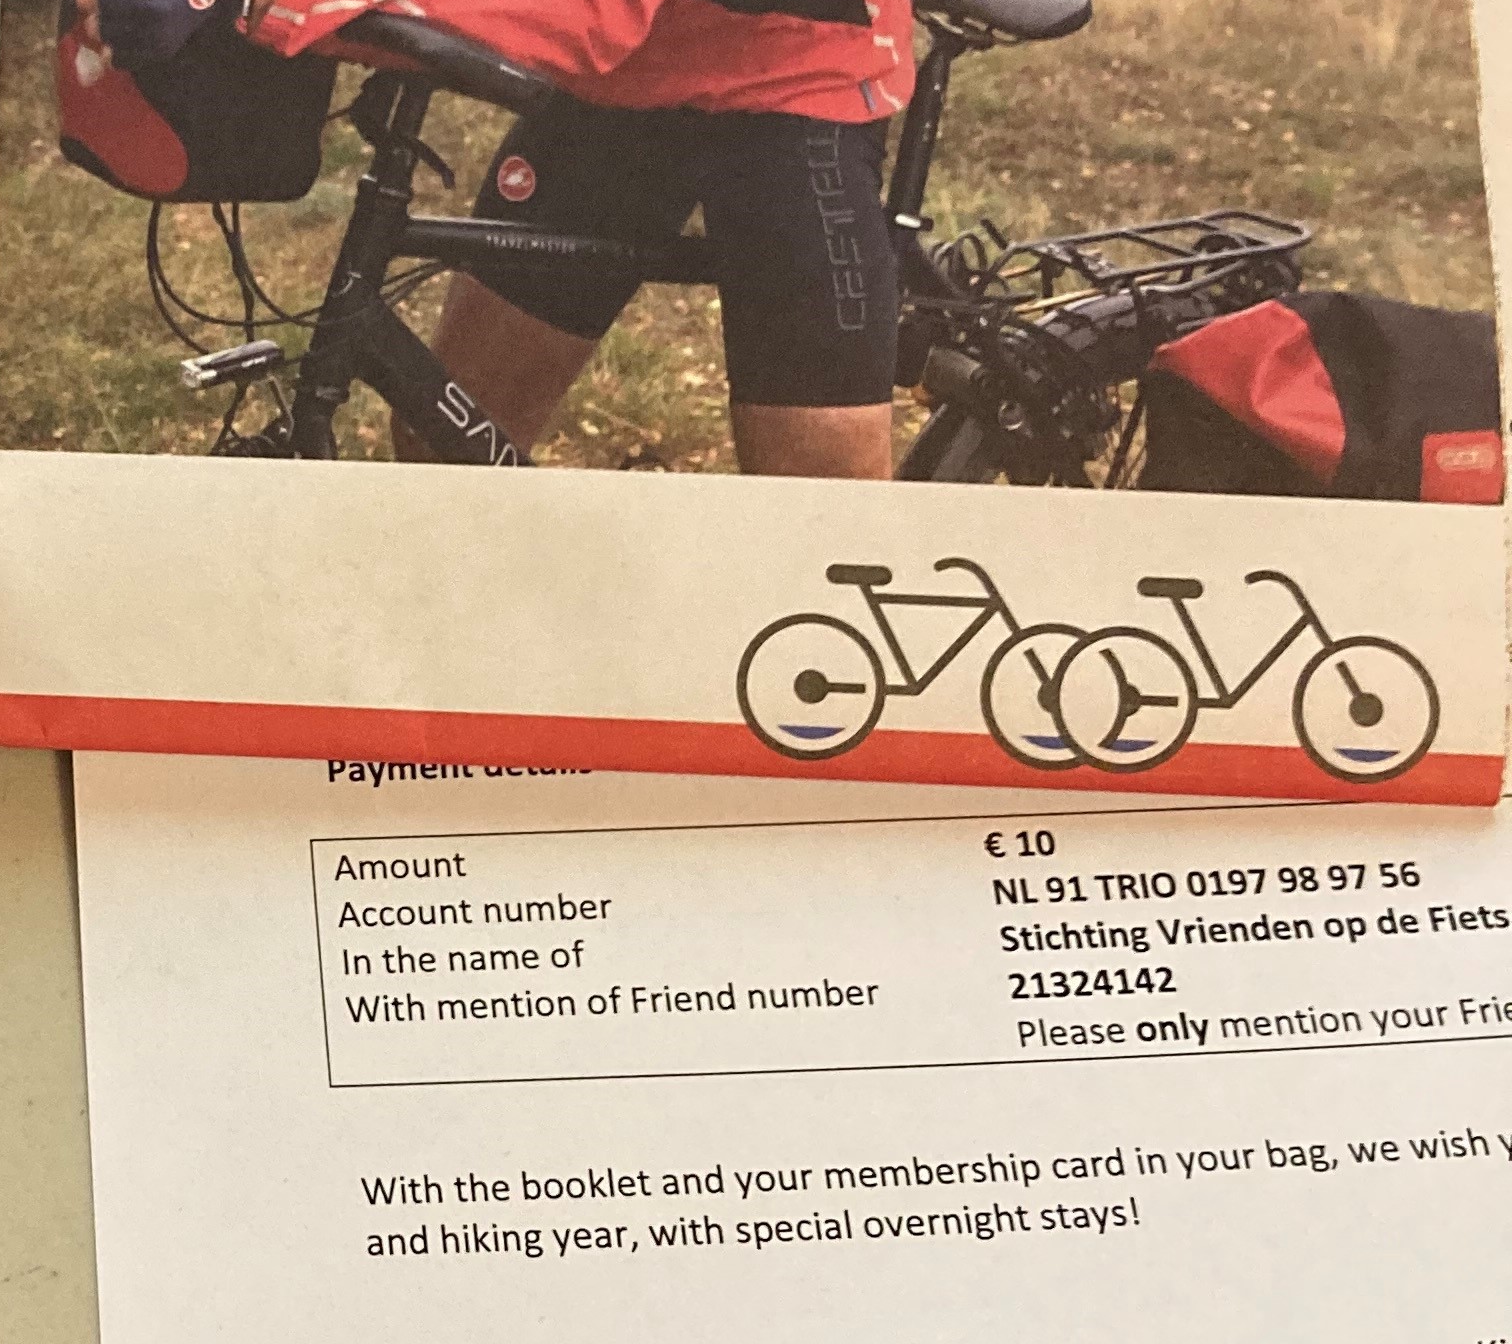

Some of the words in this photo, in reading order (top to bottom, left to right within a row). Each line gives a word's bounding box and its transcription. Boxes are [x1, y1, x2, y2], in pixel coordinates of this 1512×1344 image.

[984, 832, 1006, 857] €
[1016, 831, 1055, 856] 10
[335, 854, 466, 881] Amount
[993, 878, 1038, 905] NL
[1046, 877, 1088, 902] 91
[1094, 873, 1176, 900] TRIO
[1187, 869, 1265, 896] 0197
[1278, 867, 1319, 893] 98
[1328, 864, 1365, 890] 97
[1379, 862, 1420, 888] 56
[339, 900, 472, 927] Account
[484, 893, 612, 923] number
[1001, 921, 1150, 952] Stichting
[1157, 914, 1314, 944] Vrienden
[1324, 917, 1366, 943] op
[1378, 908, 1419, 934] de
[1428, 905, 1509, 932] Fiets
[344, 949, 371, 975] In
[382, 946, 436, 973] the
[449, 950, 539, 971] name
[551, 940, 583, 968] of
[346, 993, 425, 1022] With
[438, 991, 575, 1020] mention
[588, 986, 620, 1014] of
[632, 983, 735, 1013] Friend
[748, 979, 878, 1009] number
[1009, 967, 1176, 999] 21324142
[1018, 1019, 1125, 1047] Please
[1137, 1012, 1208, 1046] only
[1221, 1007, 1361, 1038] mention
[1369, 1007, 1447, 1036] your
[361, 1175, 443, 1204] With
[454, 1173, 509, 1202] the
[522, 1168, 651, 1200] booklet
[663, 1165, 724, 1195] and
[735, 1170, 812, 1199] your
[825, 1154, 1040, 1189] membership
[1052, 1147, 1125, 1178] card
[1135, 1148, 1167, 1174] in
[1176, 1149, 1254, 1179] your
[1265, 1140, 1338, 1172] bag,
[1348, 1141, 1400, 1162] we
[1409, 1128, 1489, 1159] wish
[368, 1225, 428, 1256] and
[441, 1223, 543, 1258] hiking
[553, 1227, 638, 1257] year,
[649, 1215, 724, 1246] with
[737, 1210, 852, 1250] special
[864, 1203, 1031, 1240] overnight
[1041, 1197, 1139, 1234] stays!
